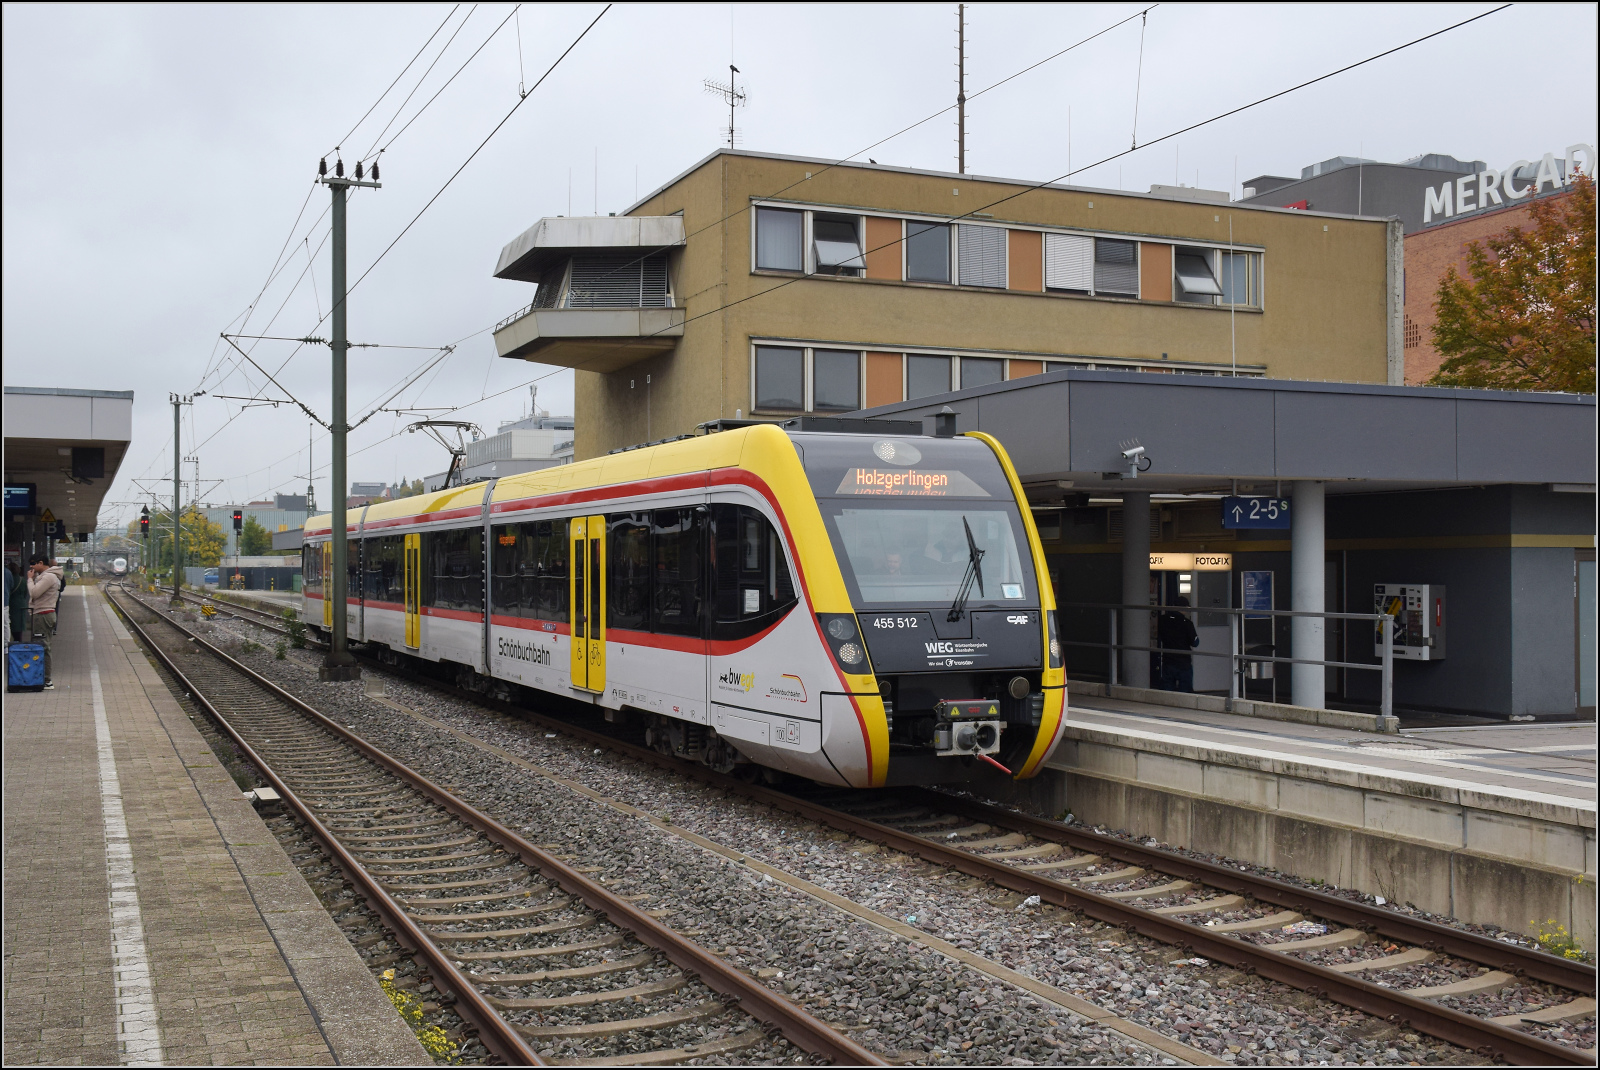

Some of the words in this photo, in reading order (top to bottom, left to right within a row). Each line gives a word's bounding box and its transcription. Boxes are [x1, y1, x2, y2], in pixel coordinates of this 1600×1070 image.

[1423, 143, 1596, 223] MERCAD
[856, 468, 948, 489] Holzgerlingen
[1249, 499, 1278, 519] 2-5
[873, 617, 895, 629] 455
[897, 617, 918, 628] 512
[1006, 615, 1029, 625] CAF
[498, 636, 551, 666] Schönbuchbahn
[924, 642, 954, 653] WEG
[729, 667, 755, 692] bwegt
[769, 687, 801, 698] Schönbuchbahn
